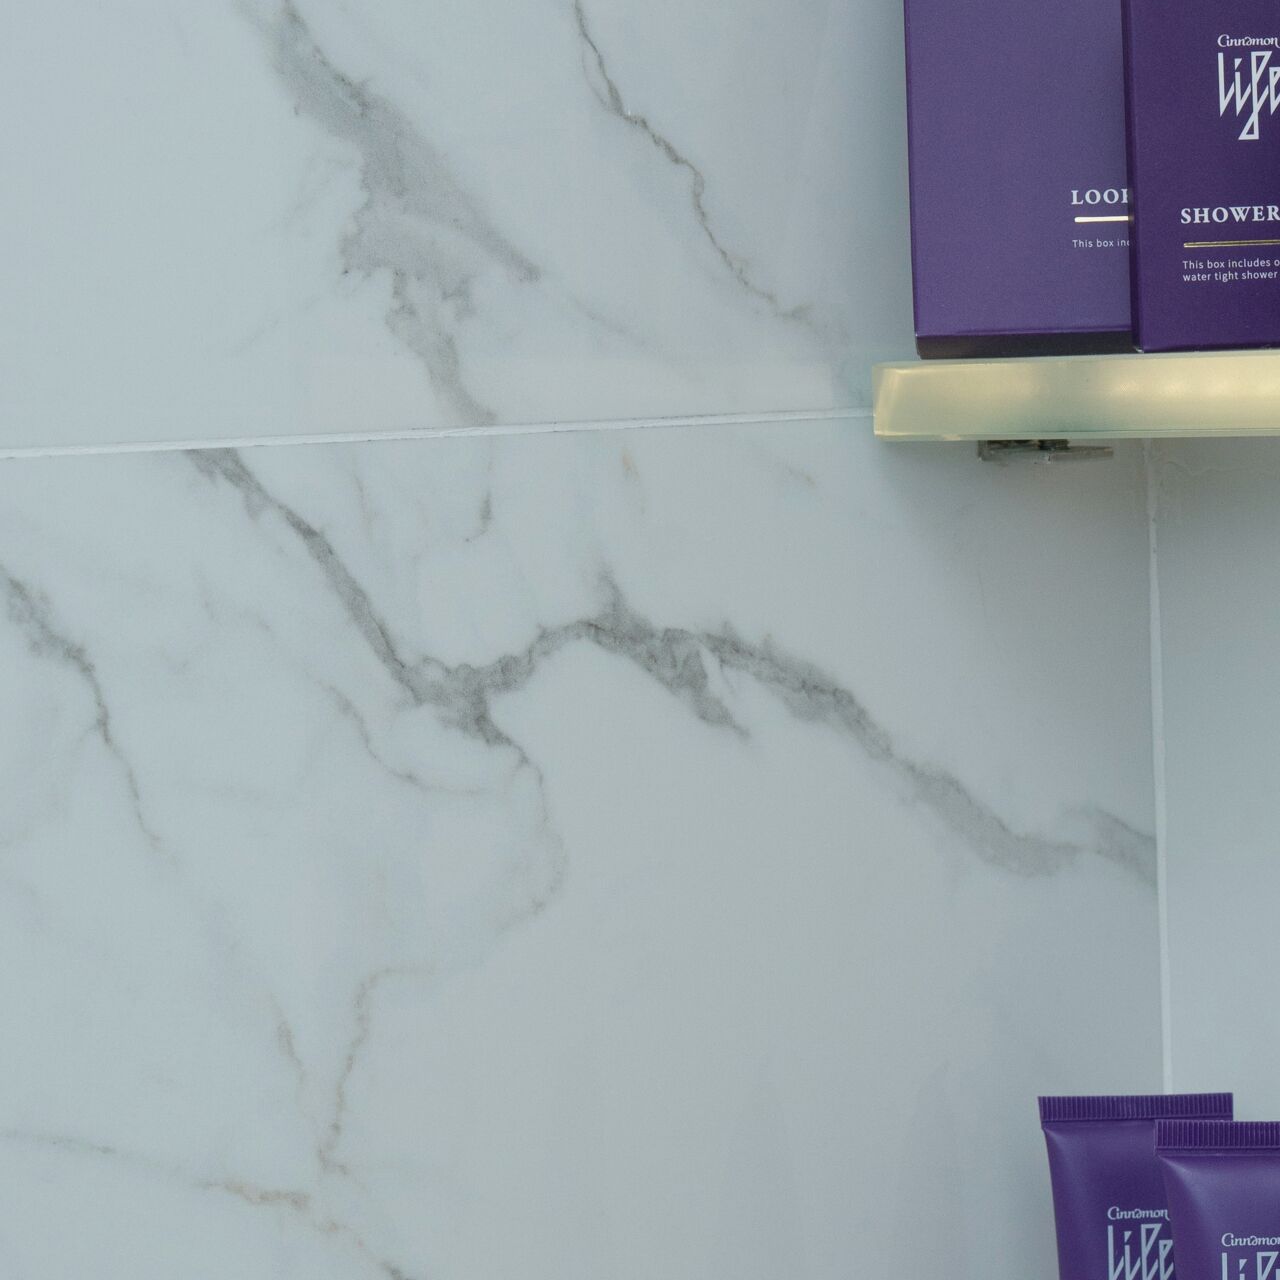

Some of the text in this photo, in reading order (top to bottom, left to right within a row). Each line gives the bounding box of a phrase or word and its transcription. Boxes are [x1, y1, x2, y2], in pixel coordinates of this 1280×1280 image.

[1072, 239, 1093, 249] This
[1096, 238, 1114, 248] box
[1182, 260, 1204, 270] This
[1207, 258, 1225, 269] box
[1228, 258, 1271, 268] includes
[1183, 272, 1211, 282] water
[1214, 271, 1238, 283] tight
[1241, 270, 1277, 280] shower
